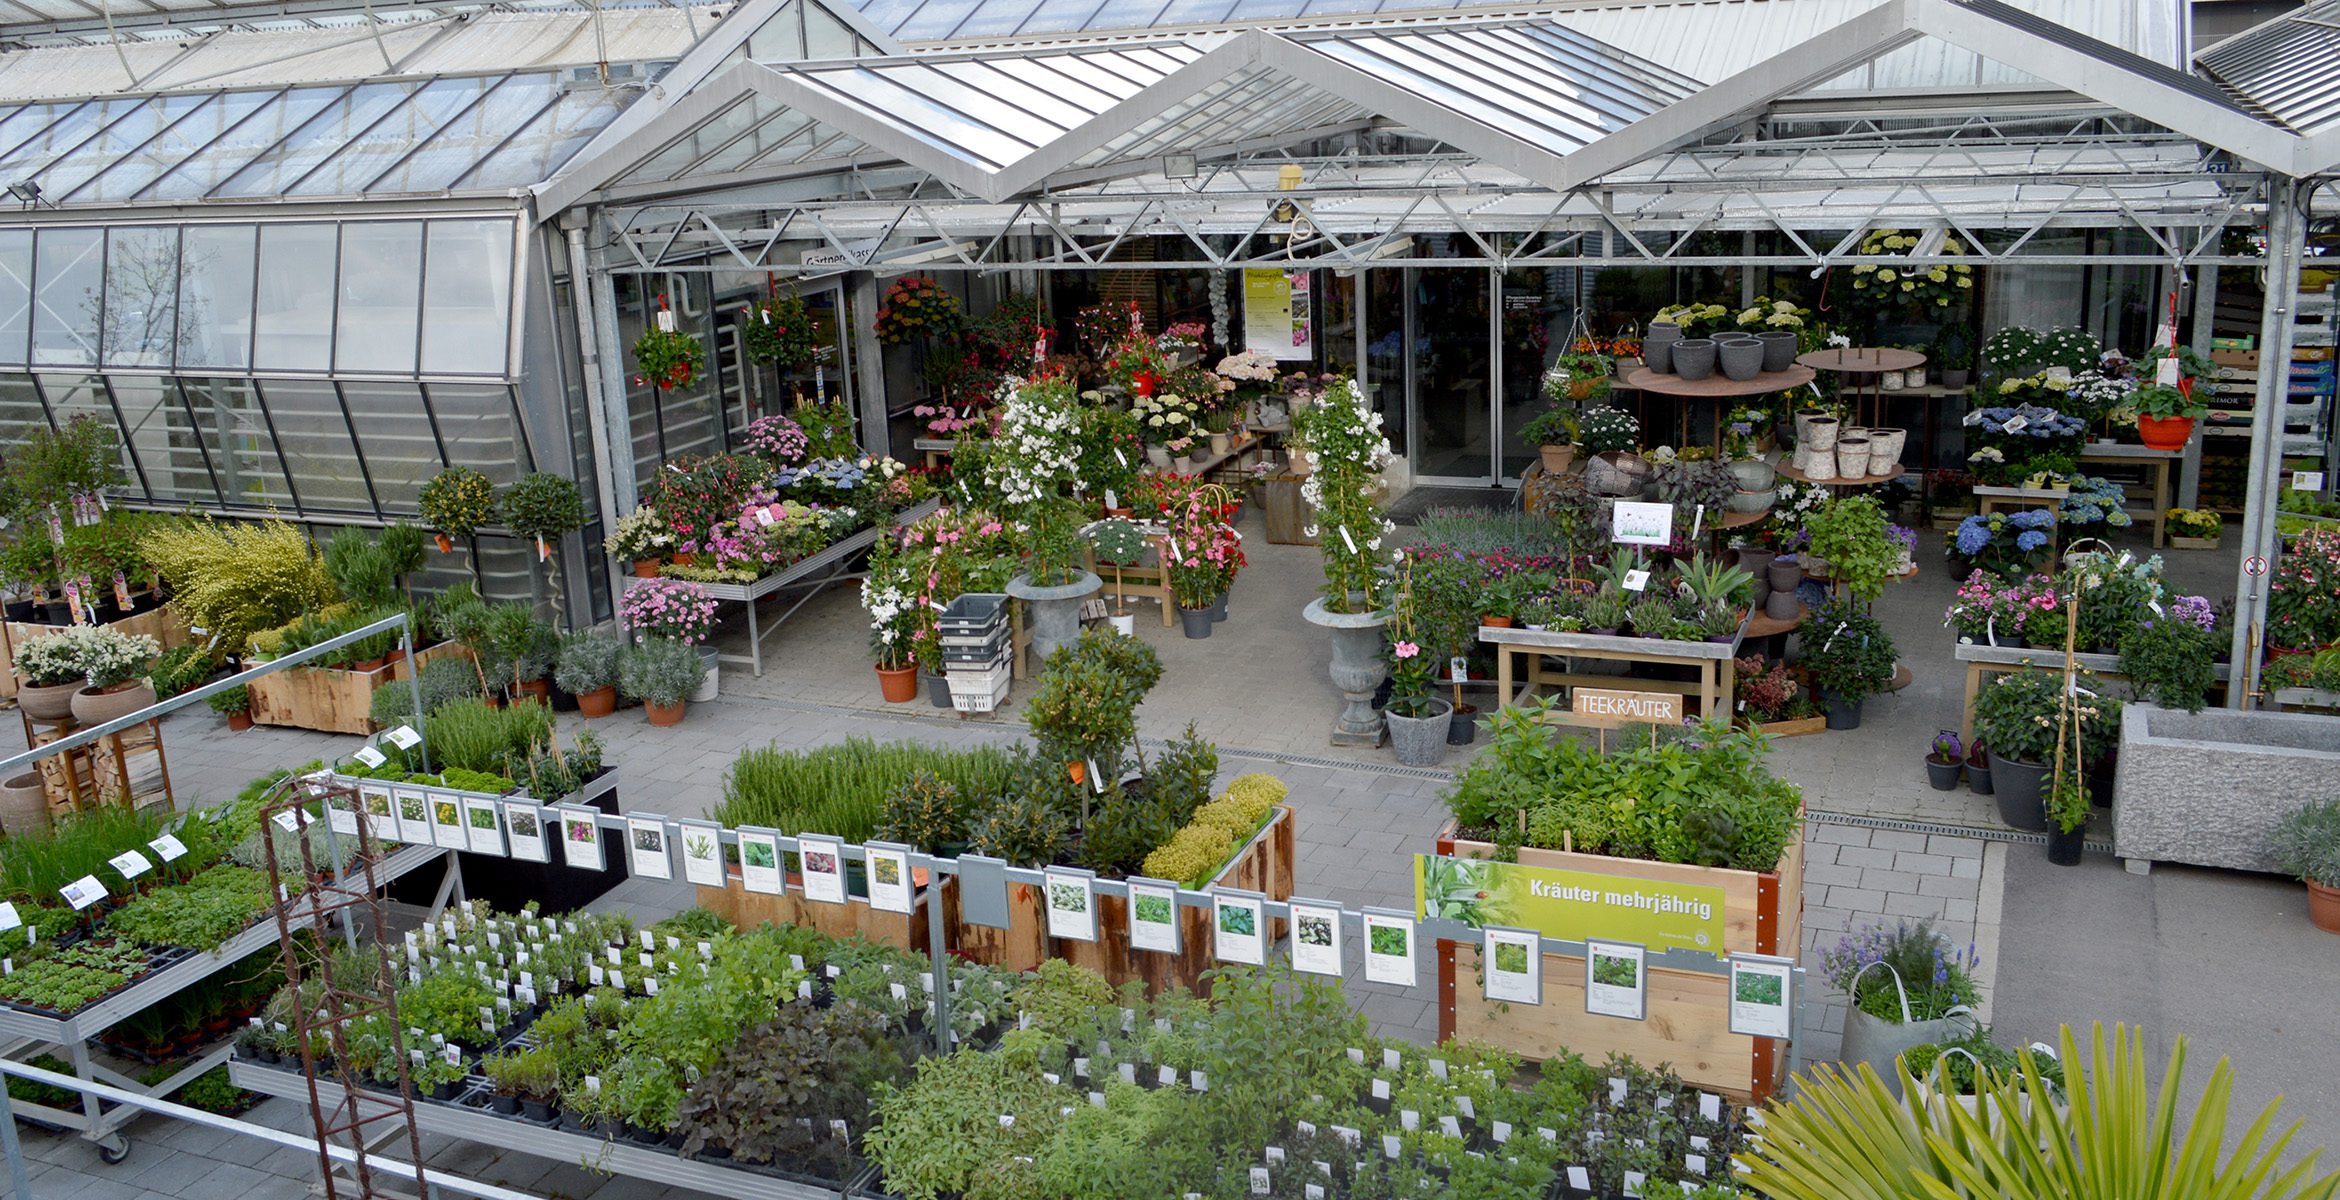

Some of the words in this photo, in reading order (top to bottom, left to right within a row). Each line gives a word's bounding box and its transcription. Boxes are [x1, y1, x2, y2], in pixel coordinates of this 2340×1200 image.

[2210, 396, 2238, 405] RIMOR
[1580, 695, 1672, 719] TEEKRÄUTER
[1530, 879, 1600, 903] Kräuter
[1605, 891, 1711, 920] mehrjährig
